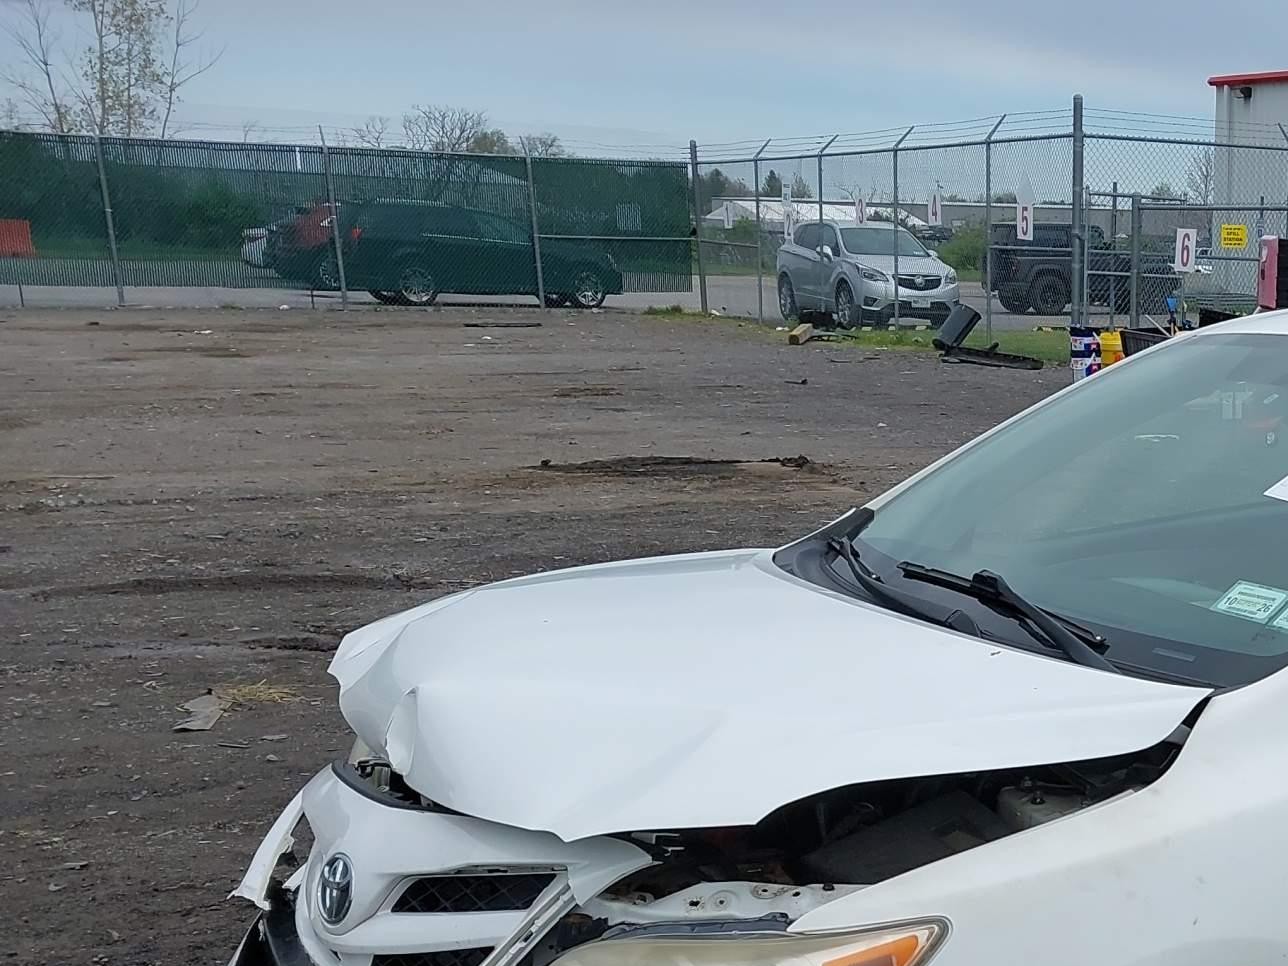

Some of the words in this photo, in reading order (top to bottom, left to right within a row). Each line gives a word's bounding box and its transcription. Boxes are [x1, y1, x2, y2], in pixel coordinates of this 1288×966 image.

[857, 198, 864, 224] 3
[931, 194, 938, 222] 4
[1021, 206, 1029, 236] 5
[1181, 232, 1191, 268] 6
[1223, 596, 1238, 606] 10
[1256, 603, 1273, 613] 26
